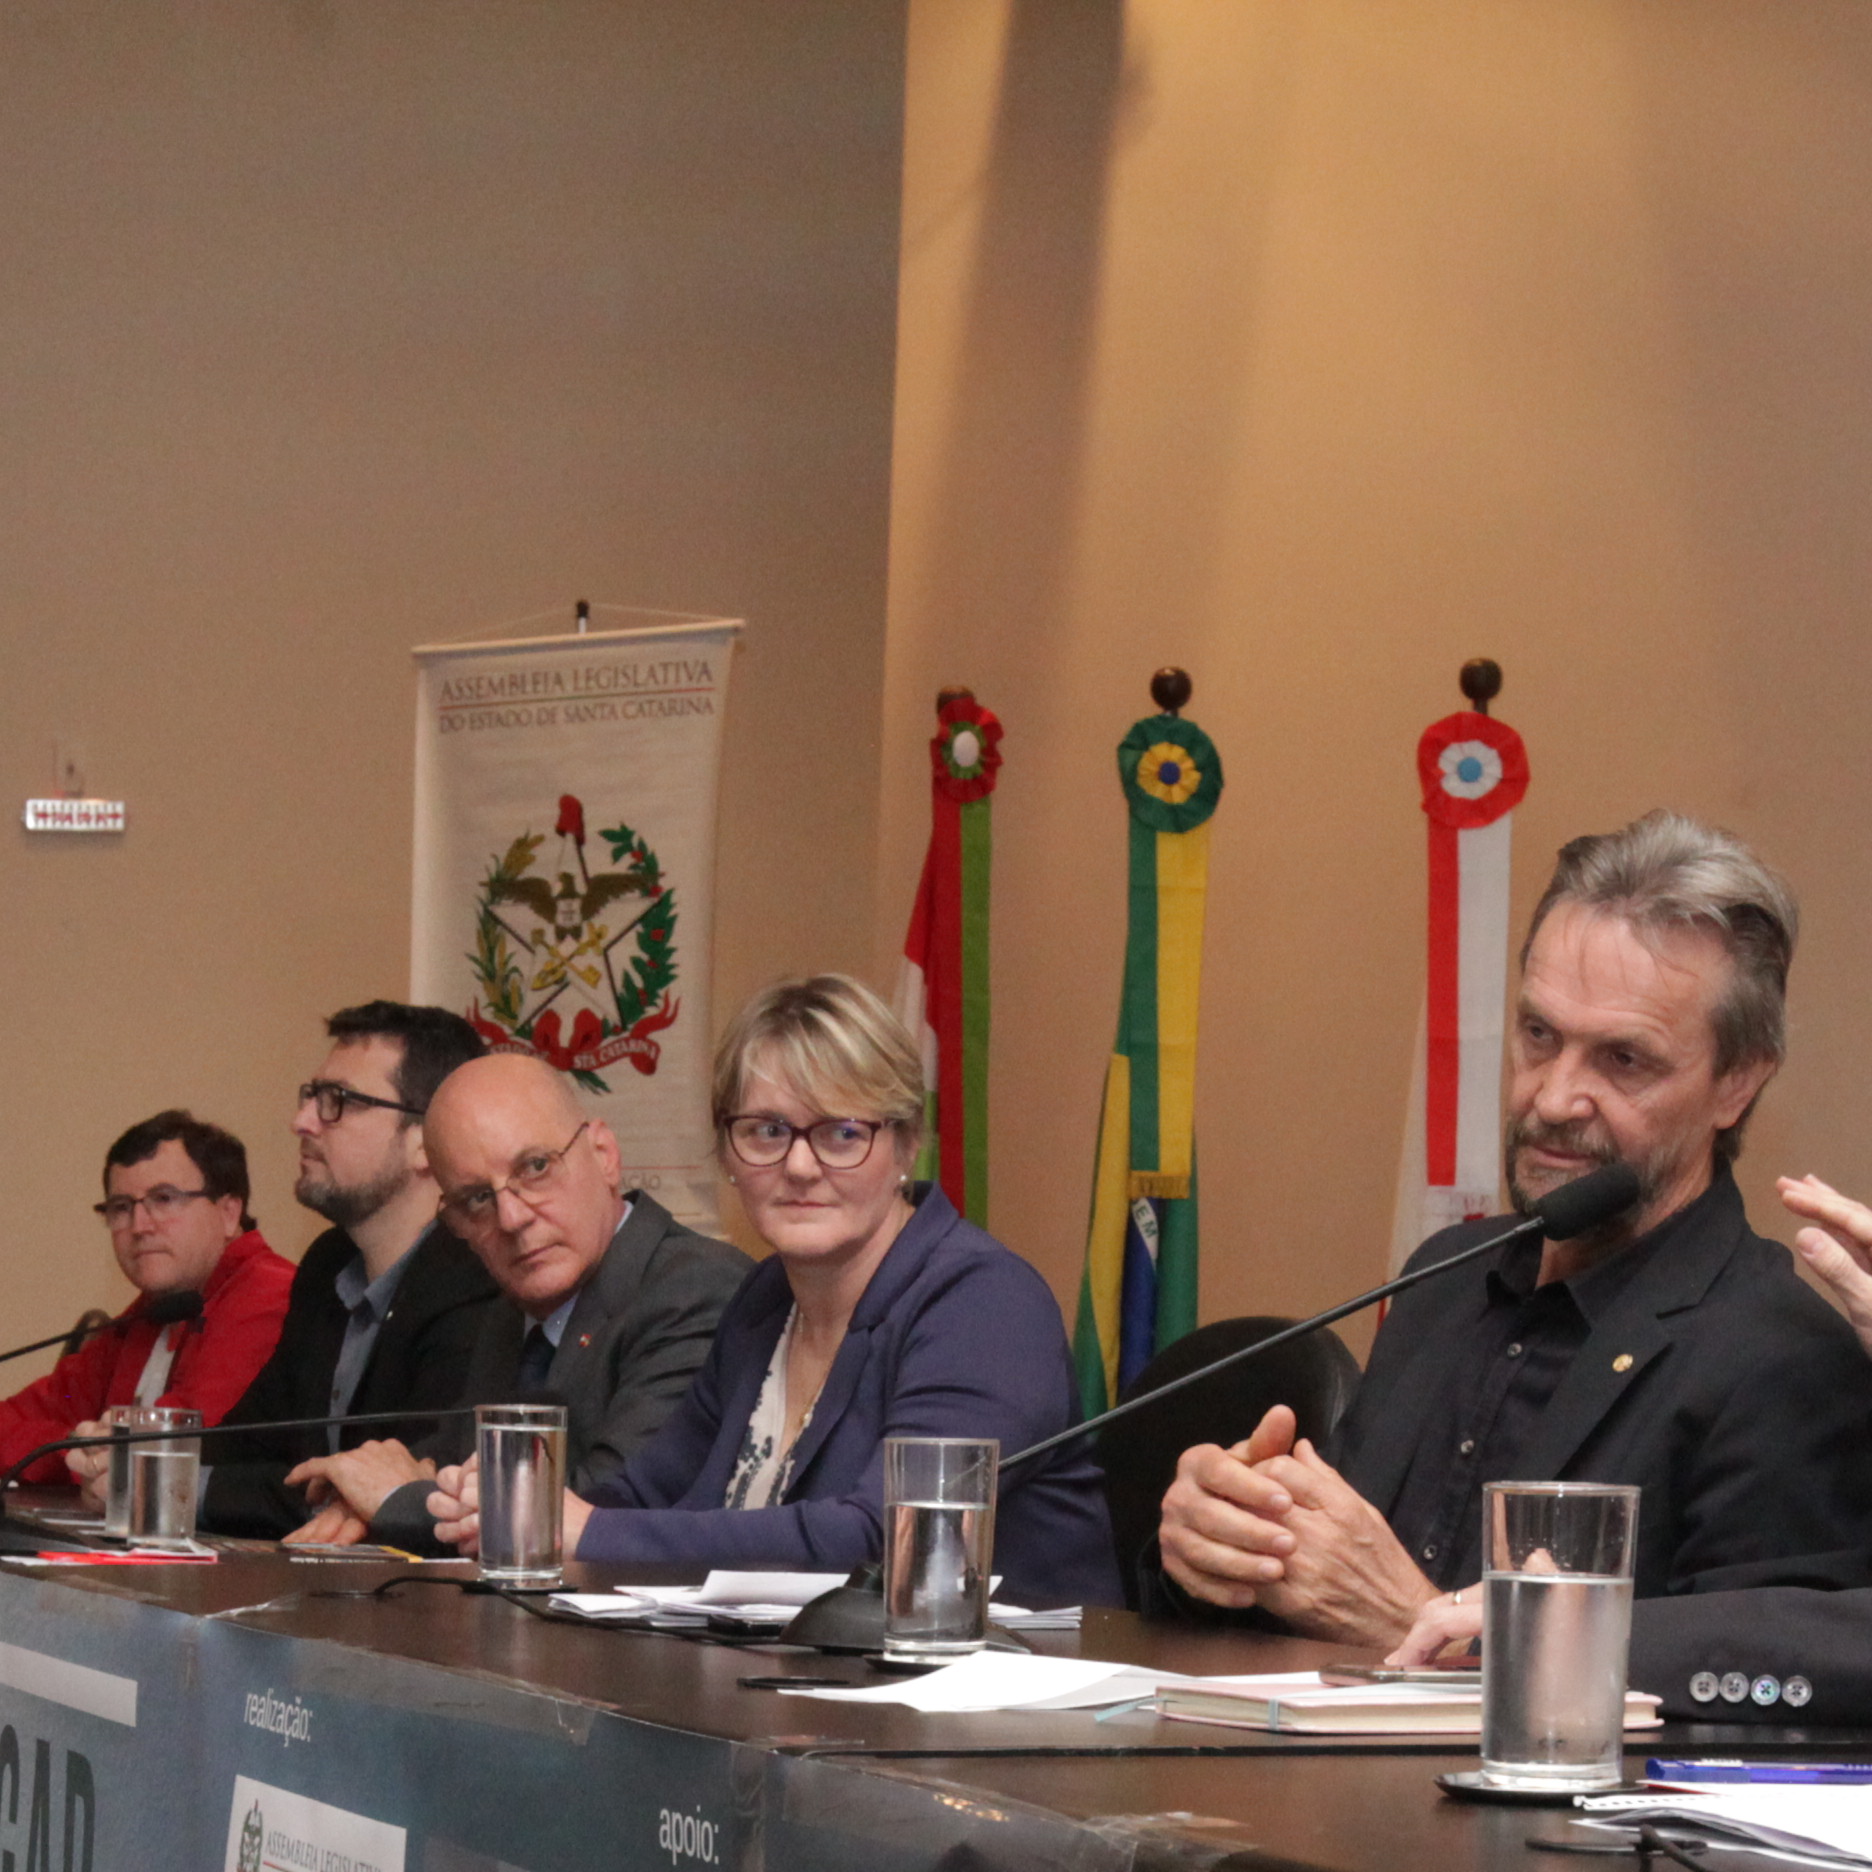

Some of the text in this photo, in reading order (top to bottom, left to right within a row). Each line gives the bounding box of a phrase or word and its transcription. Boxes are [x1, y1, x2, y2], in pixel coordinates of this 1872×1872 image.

[438, 660, 713, 703] ASSEMBLEIA LEGISLATIVA
[438, 697, 714, 734] DO ESTADO DE SANTA CATARINA
[243, 1687, 314, 1747] realização:
[658, 1804, 720, 1866] apoio:
